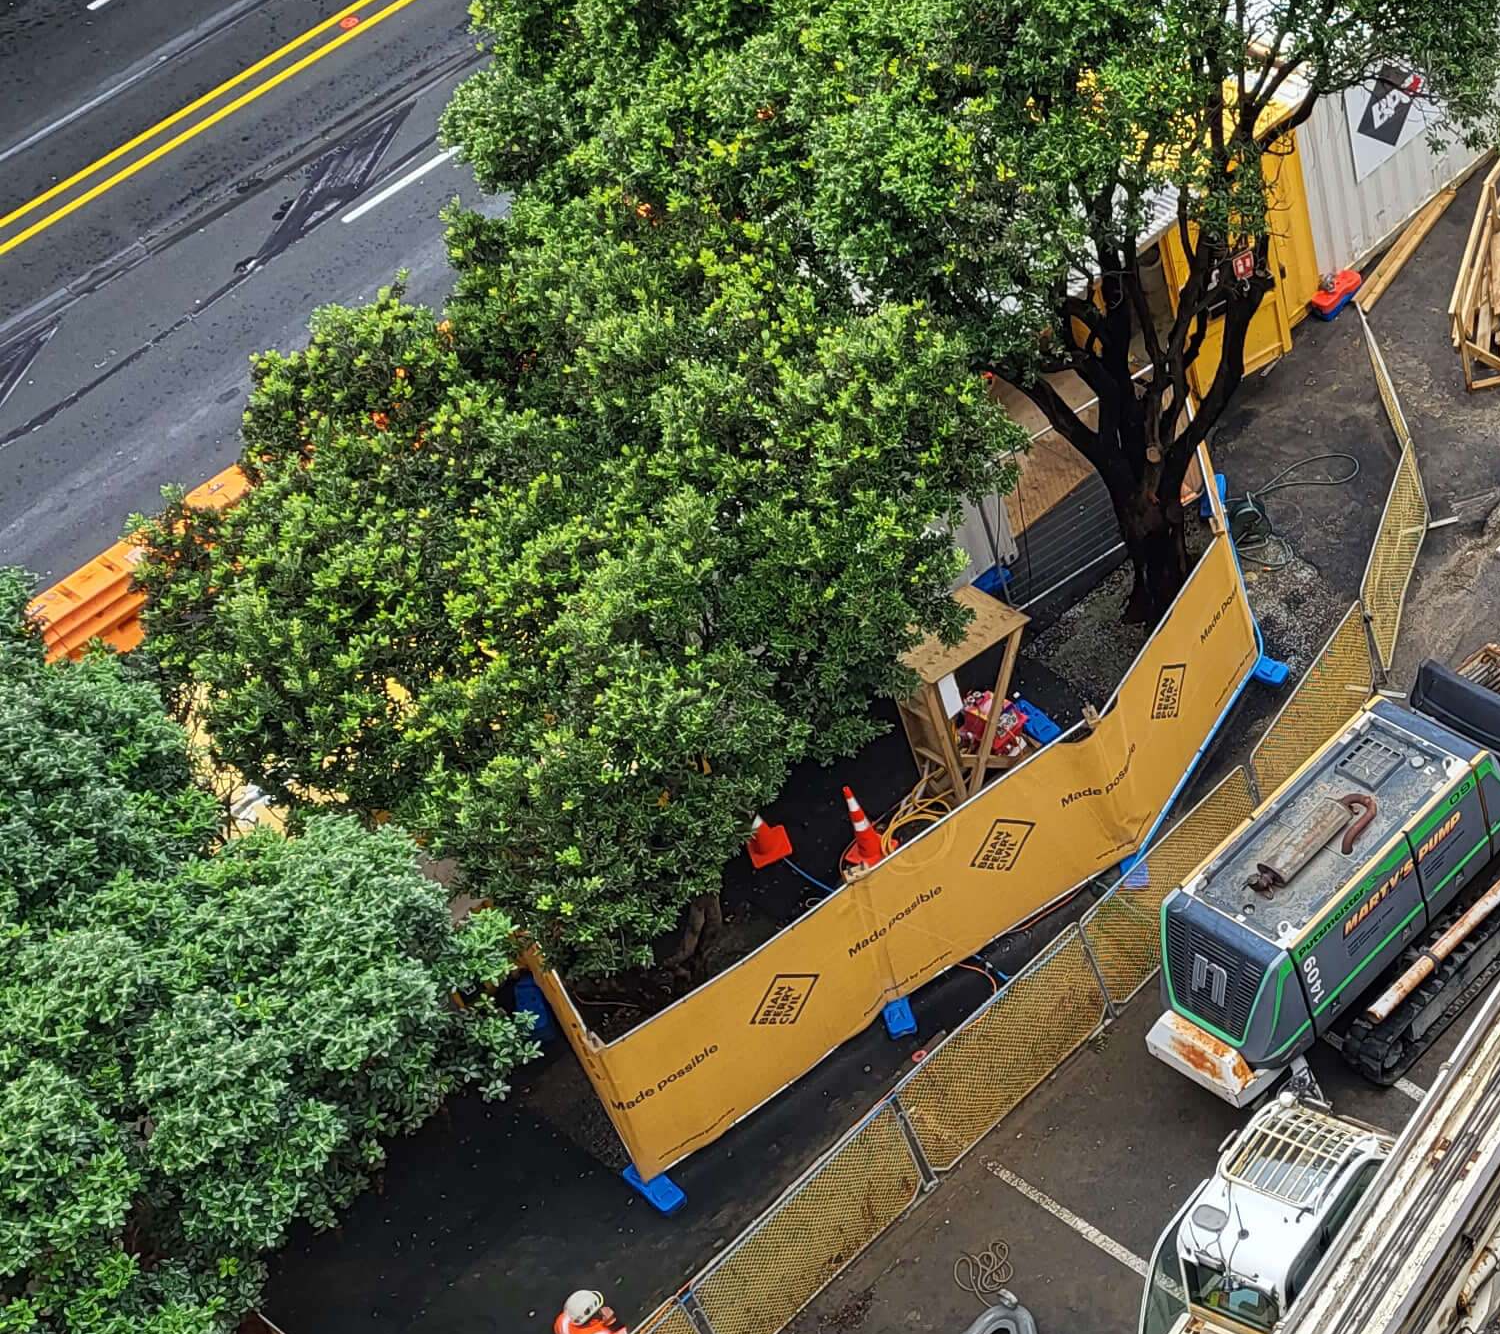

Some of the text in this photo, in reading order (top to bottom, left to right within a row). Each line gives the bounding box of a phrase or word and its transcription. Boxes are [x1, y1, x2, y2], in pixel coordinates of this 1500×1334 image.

[1200, 610, 1221, 644] Made
[1061, 787, 1103, 808] Made
[976, 829, 1004, 869] BRIAN
[986, 830, 1013, 871] PERRY
[995, 840, 1019, 871] CIVIL
[1343, 857, 1415, 941] MARTY'S
[1417, 810, 1462, 866] PUMP
[848, 885, 944, 958] Made possible
[1298, 886, 1367, 958] Putzmeister
[1303, 955, 1326, 1005] 1409
[758, 985, 787, 1025] BRIAN
[768, 984, 797, 1025] PERRY
[778, 992, 804, 1025] CIVIL
[610, 1043, 720, 1113] Made possible
